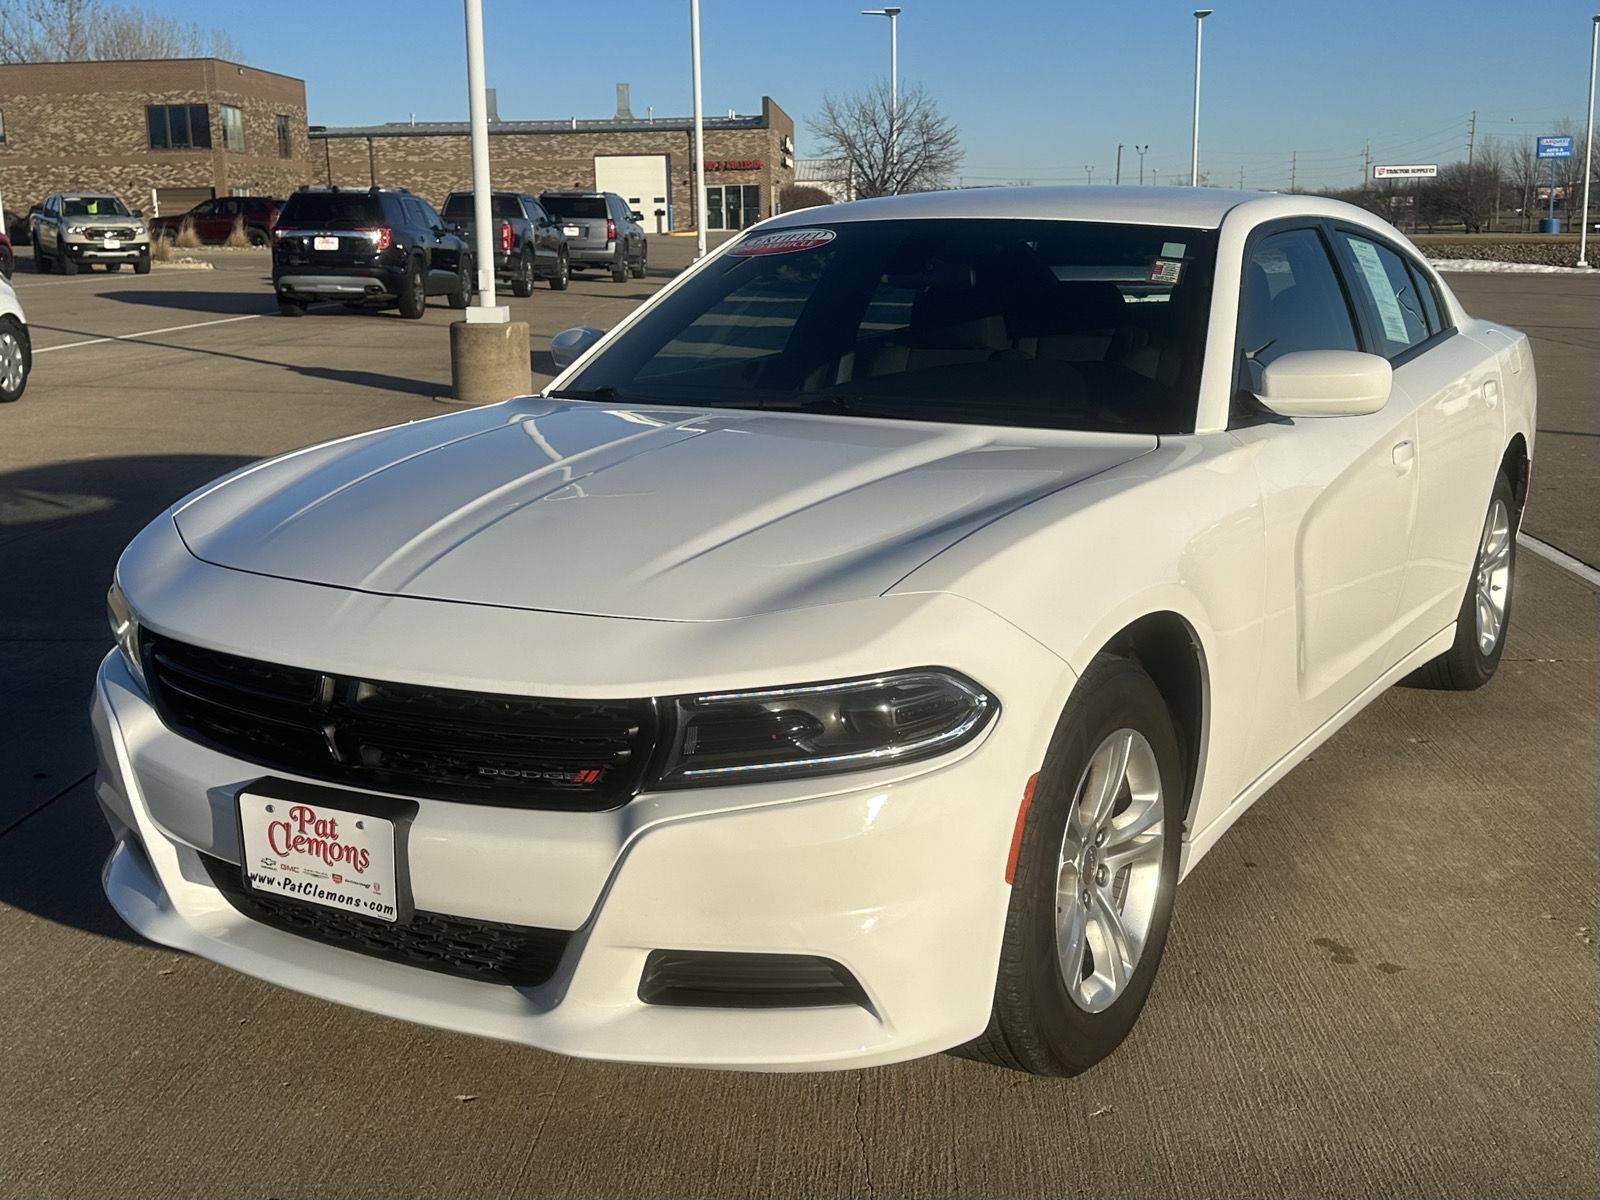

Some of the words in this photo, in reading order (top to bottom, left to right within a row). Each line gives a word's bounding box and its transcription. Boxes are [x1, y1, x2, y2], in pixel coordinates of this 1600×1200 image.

[479, 767, 582, 780] DODGE
[289, 805, 339, 840] Pat
[268, 820, 370, 874] Clemons
[280, 863, 301, 873] GMC
